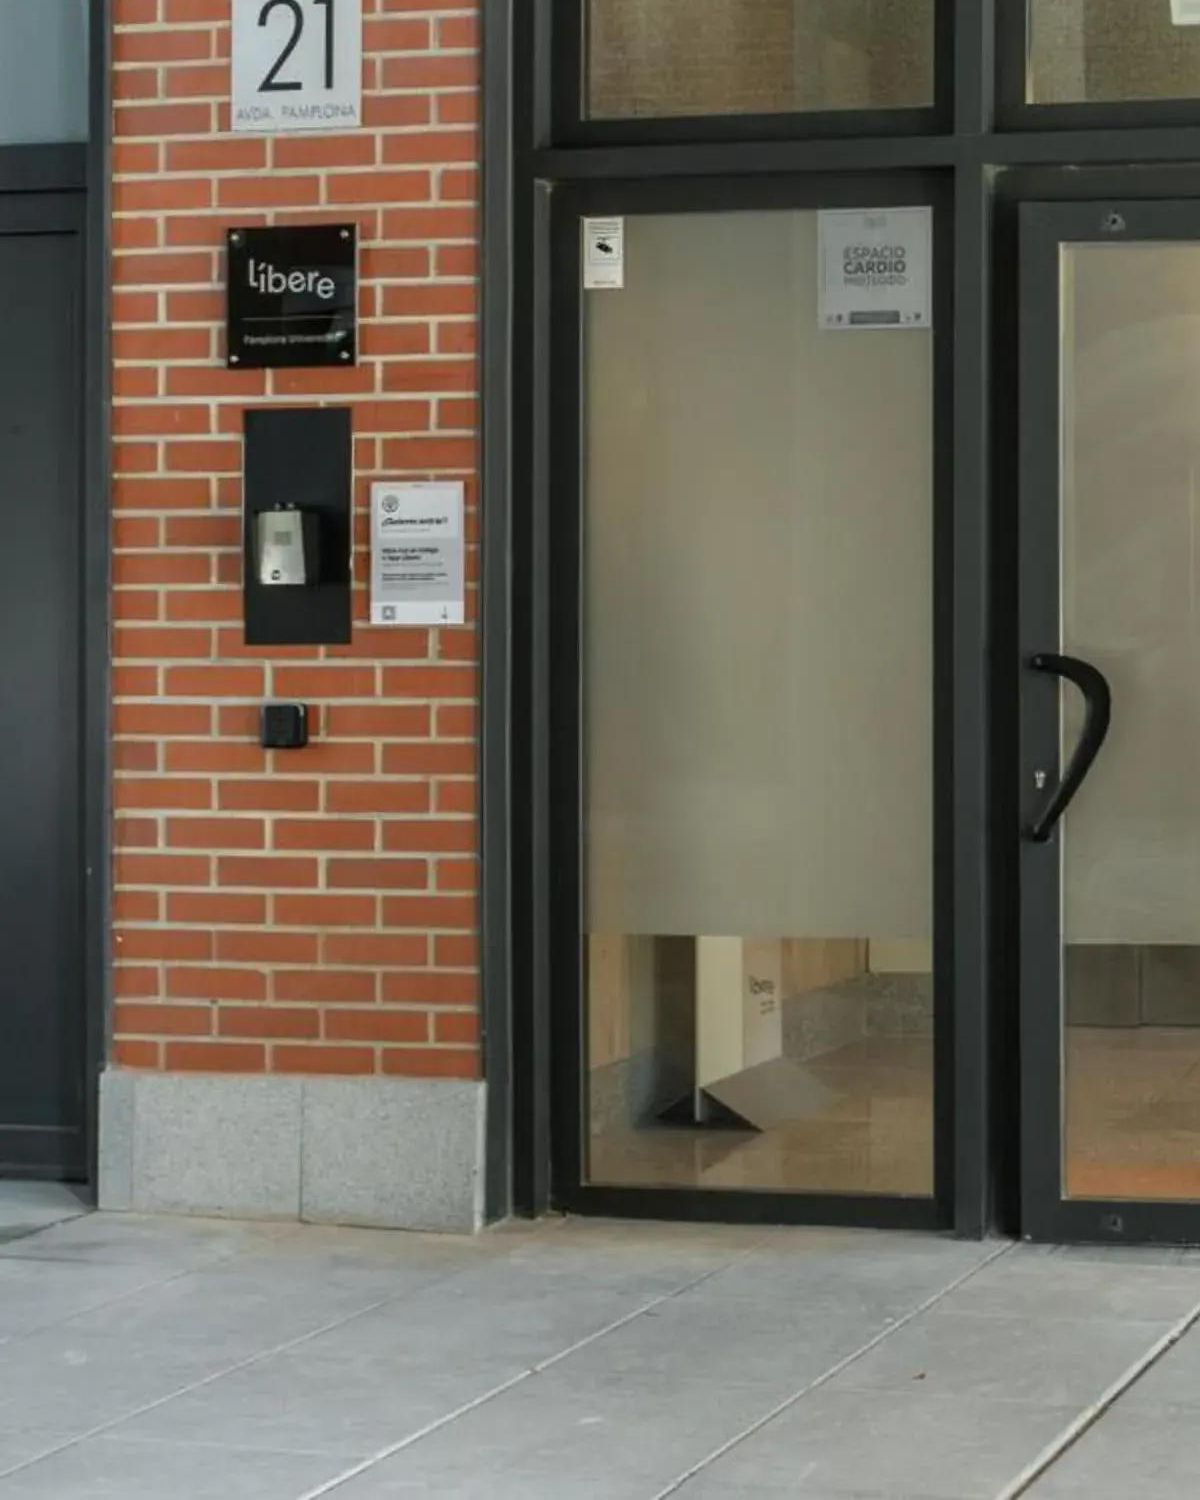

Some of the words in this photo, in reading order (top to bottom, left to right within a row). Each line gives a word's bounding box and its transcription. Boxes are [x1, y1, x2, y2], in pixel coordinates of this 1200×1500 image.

[281, 102, 356, 120] PAMPLONA
[843, 245, 906, 260] ESPACIO
[843, 260, 906, 274] CARDIO
